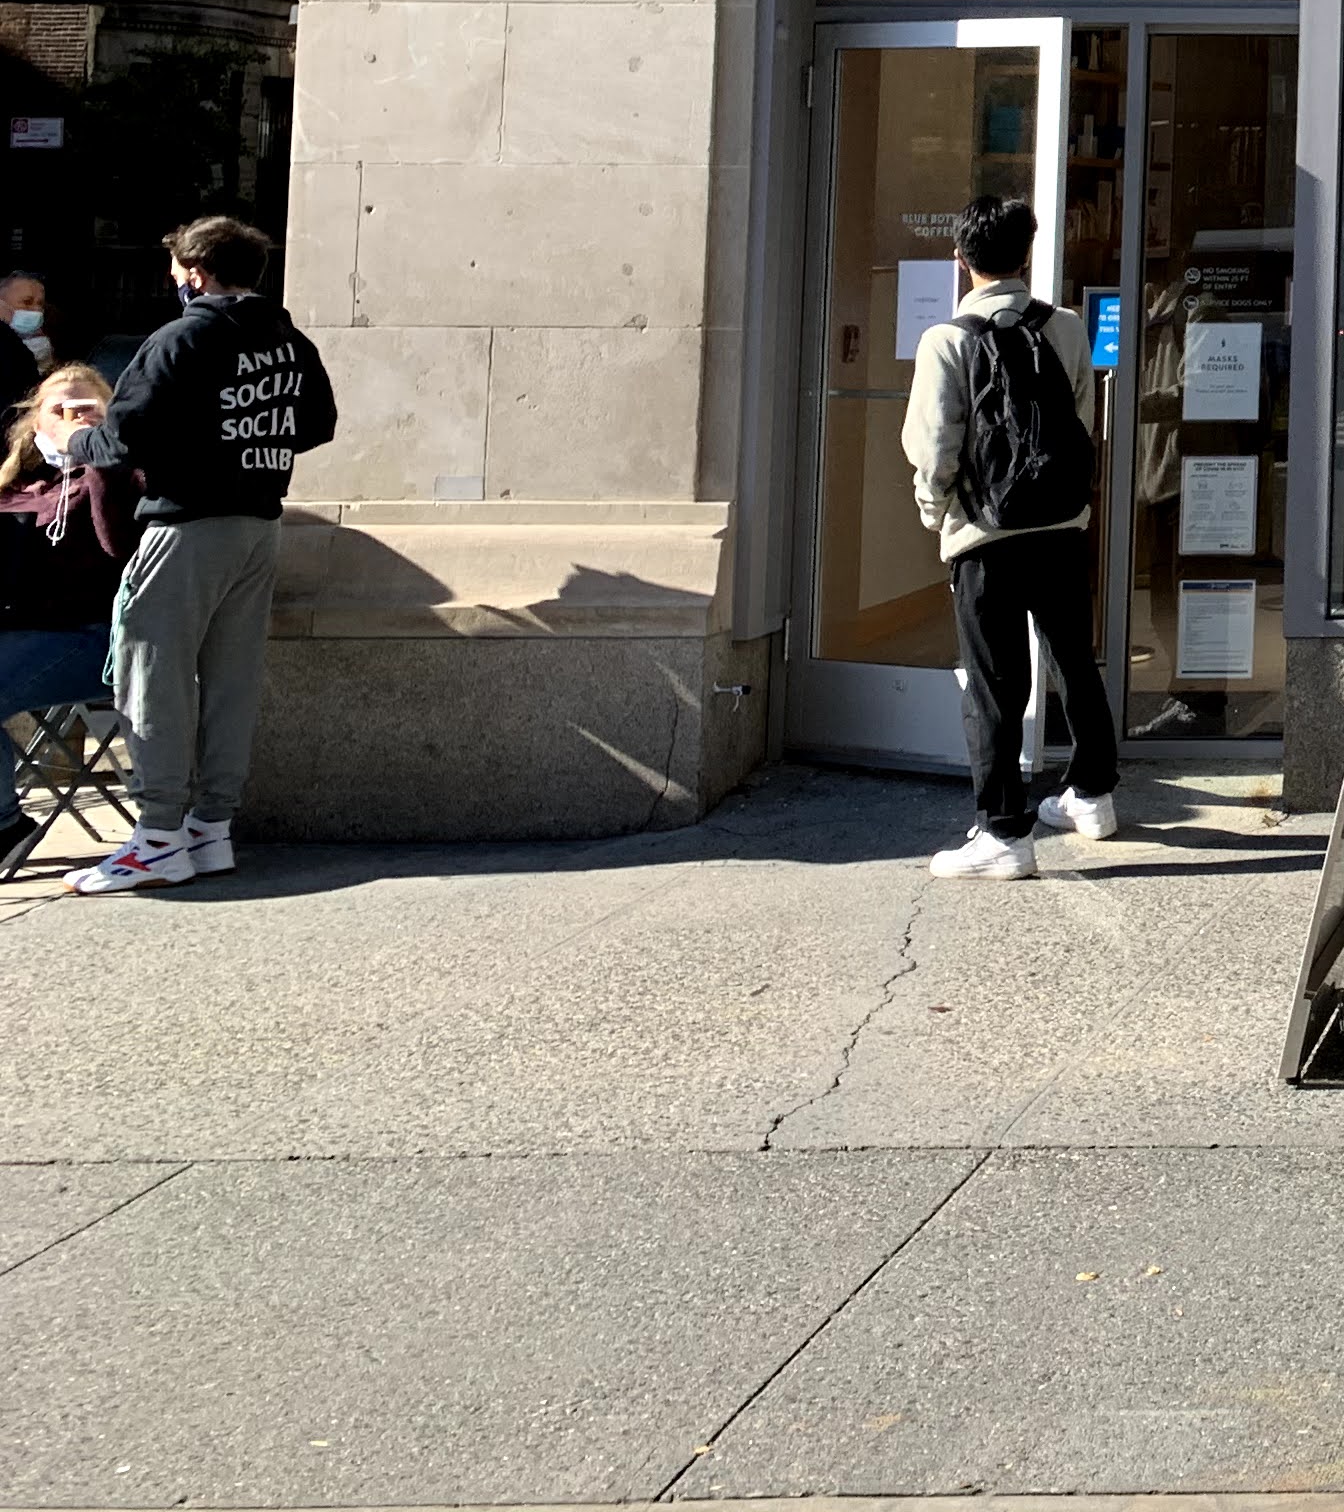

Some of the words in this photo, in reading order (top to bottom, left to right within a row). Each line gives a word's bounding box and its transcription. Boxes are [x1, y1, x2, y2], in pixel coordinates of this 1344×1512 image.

[902, 214, 927, 223] BLUE
[930, 214, 958, 223] BOTT
[237, 343, 295, 376] ANTI
[1201, 363, 1244, 371] REQUIRED
[221, 406, 296, 440] SOCIA
[241, 448, 293, 470] CLUB
